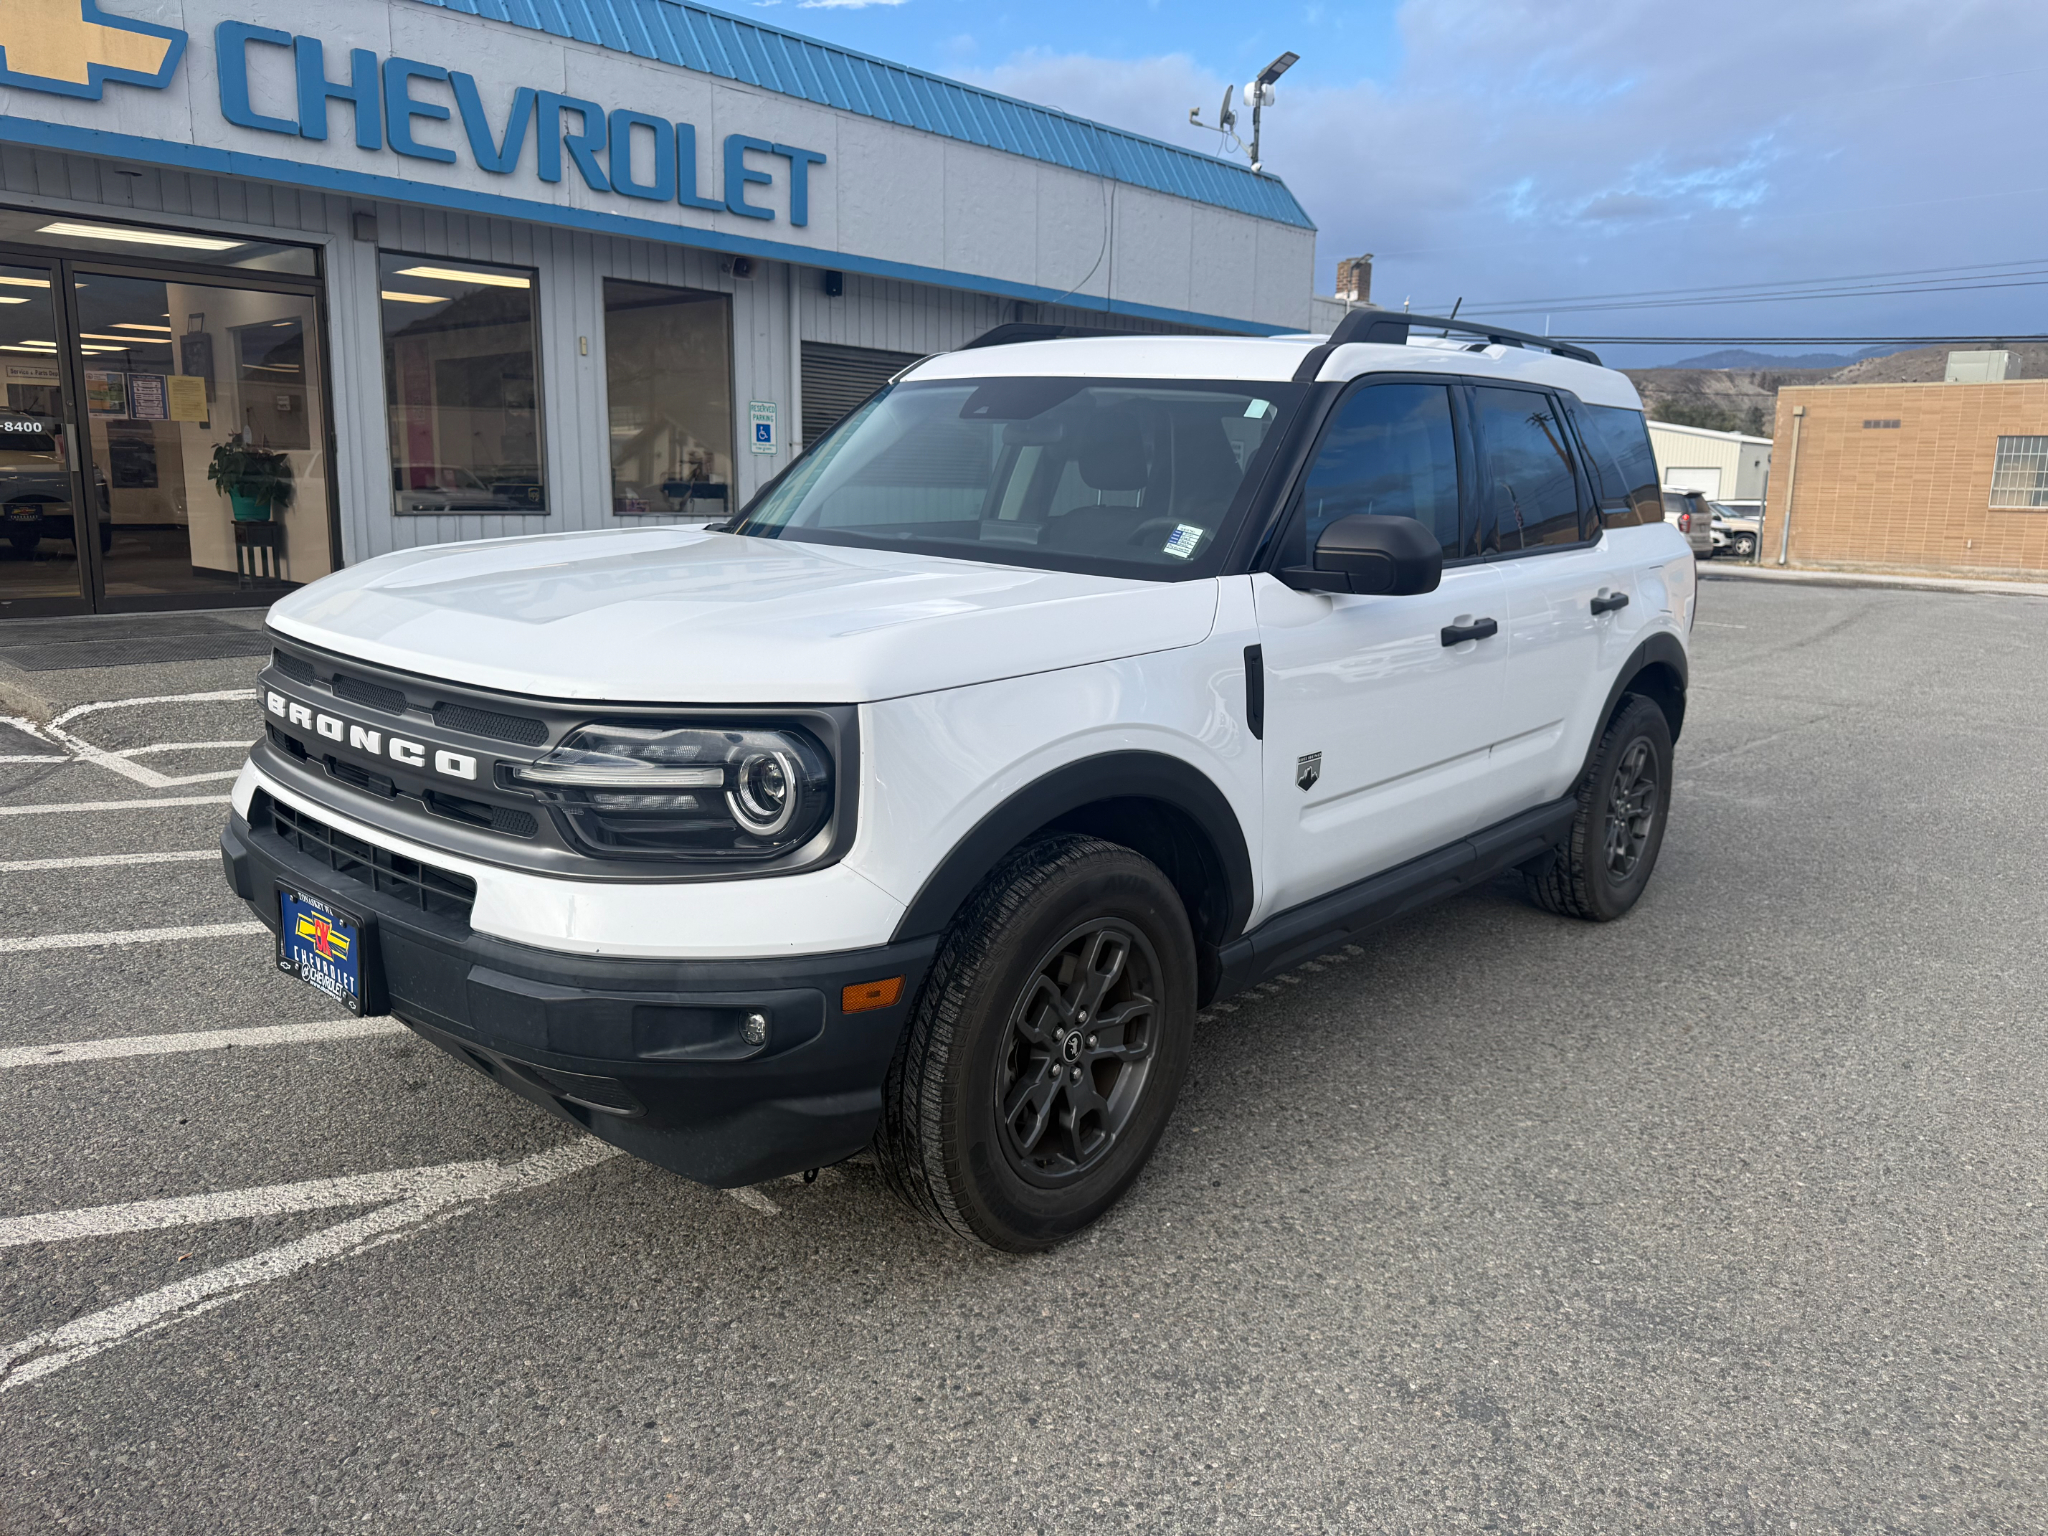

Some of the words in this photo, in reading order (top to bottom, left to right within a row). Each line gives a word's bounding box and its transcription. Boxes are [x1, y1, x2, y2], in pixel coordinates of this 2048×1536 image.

[214, 19, 827, 227] CHEVROLET
[750, 404, 776, 414] RESERVED
[752, 413, 775, 423] PARKING
[267, 691, 478, 781] BRONCO
[314, 918, 332, 957] OK
[293, 945, 355, 993] CHEVROLET
[310, 967, 343, 997] CHEVROLET
